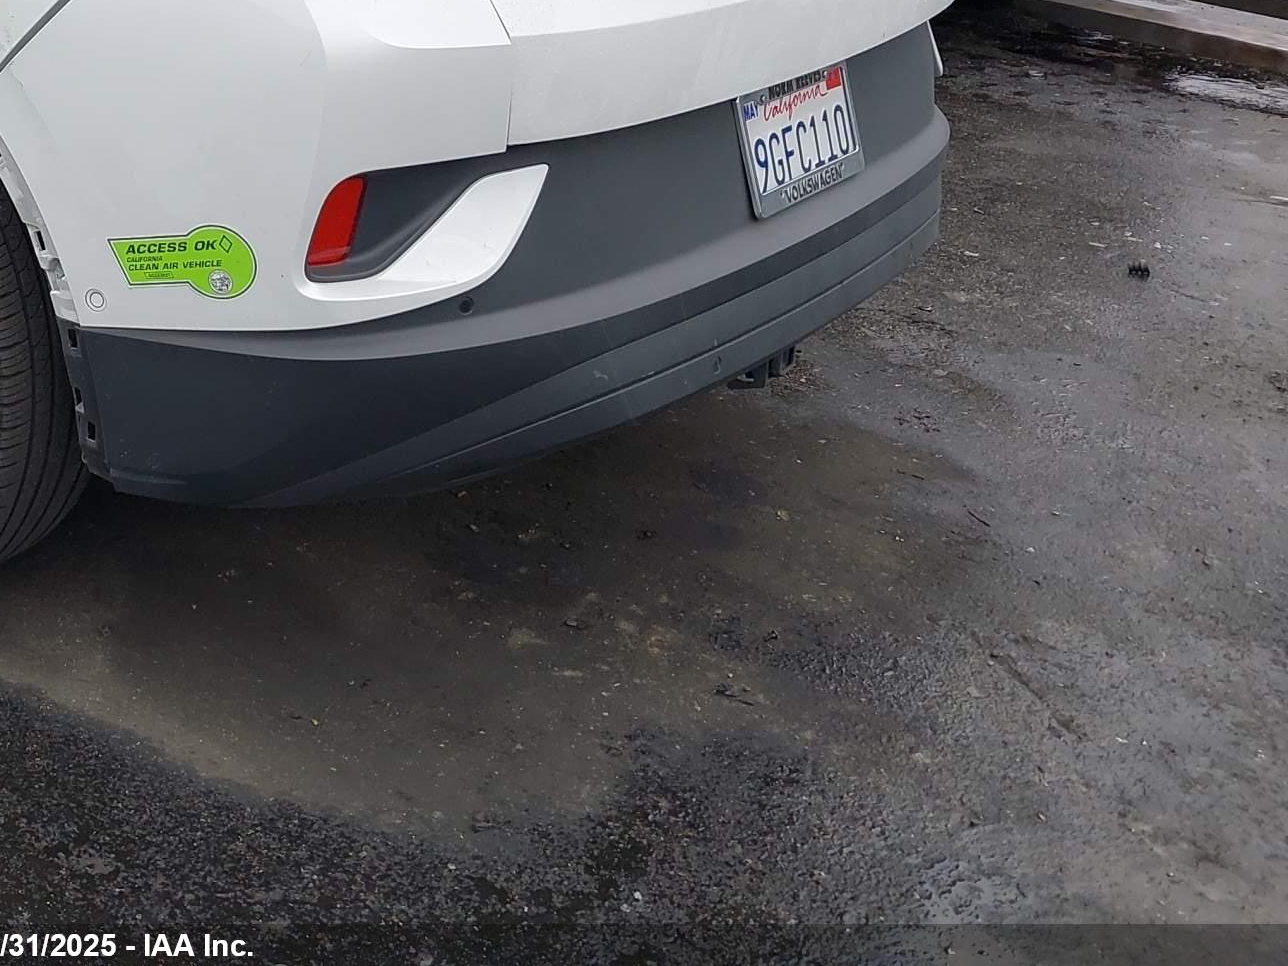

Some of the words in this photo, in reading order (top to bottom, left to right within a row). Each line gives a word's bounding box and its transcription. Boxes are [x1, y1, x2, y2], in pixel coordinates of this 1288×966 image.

[743, 100, 759, 121] MAY
[763, 84, 828, 122] California
[754, 104, 850, 194] 9GFC110
[126, 241, 188, 255] ACCESS
[194, 239, 218, 252] OK
[127, 255, 163, 263] CALIFORNIA
[128, 263, 159, 272] CLEAN
[162, 262, 179, 270] AIR
[182, 259, 223, 269] VEHICLE
